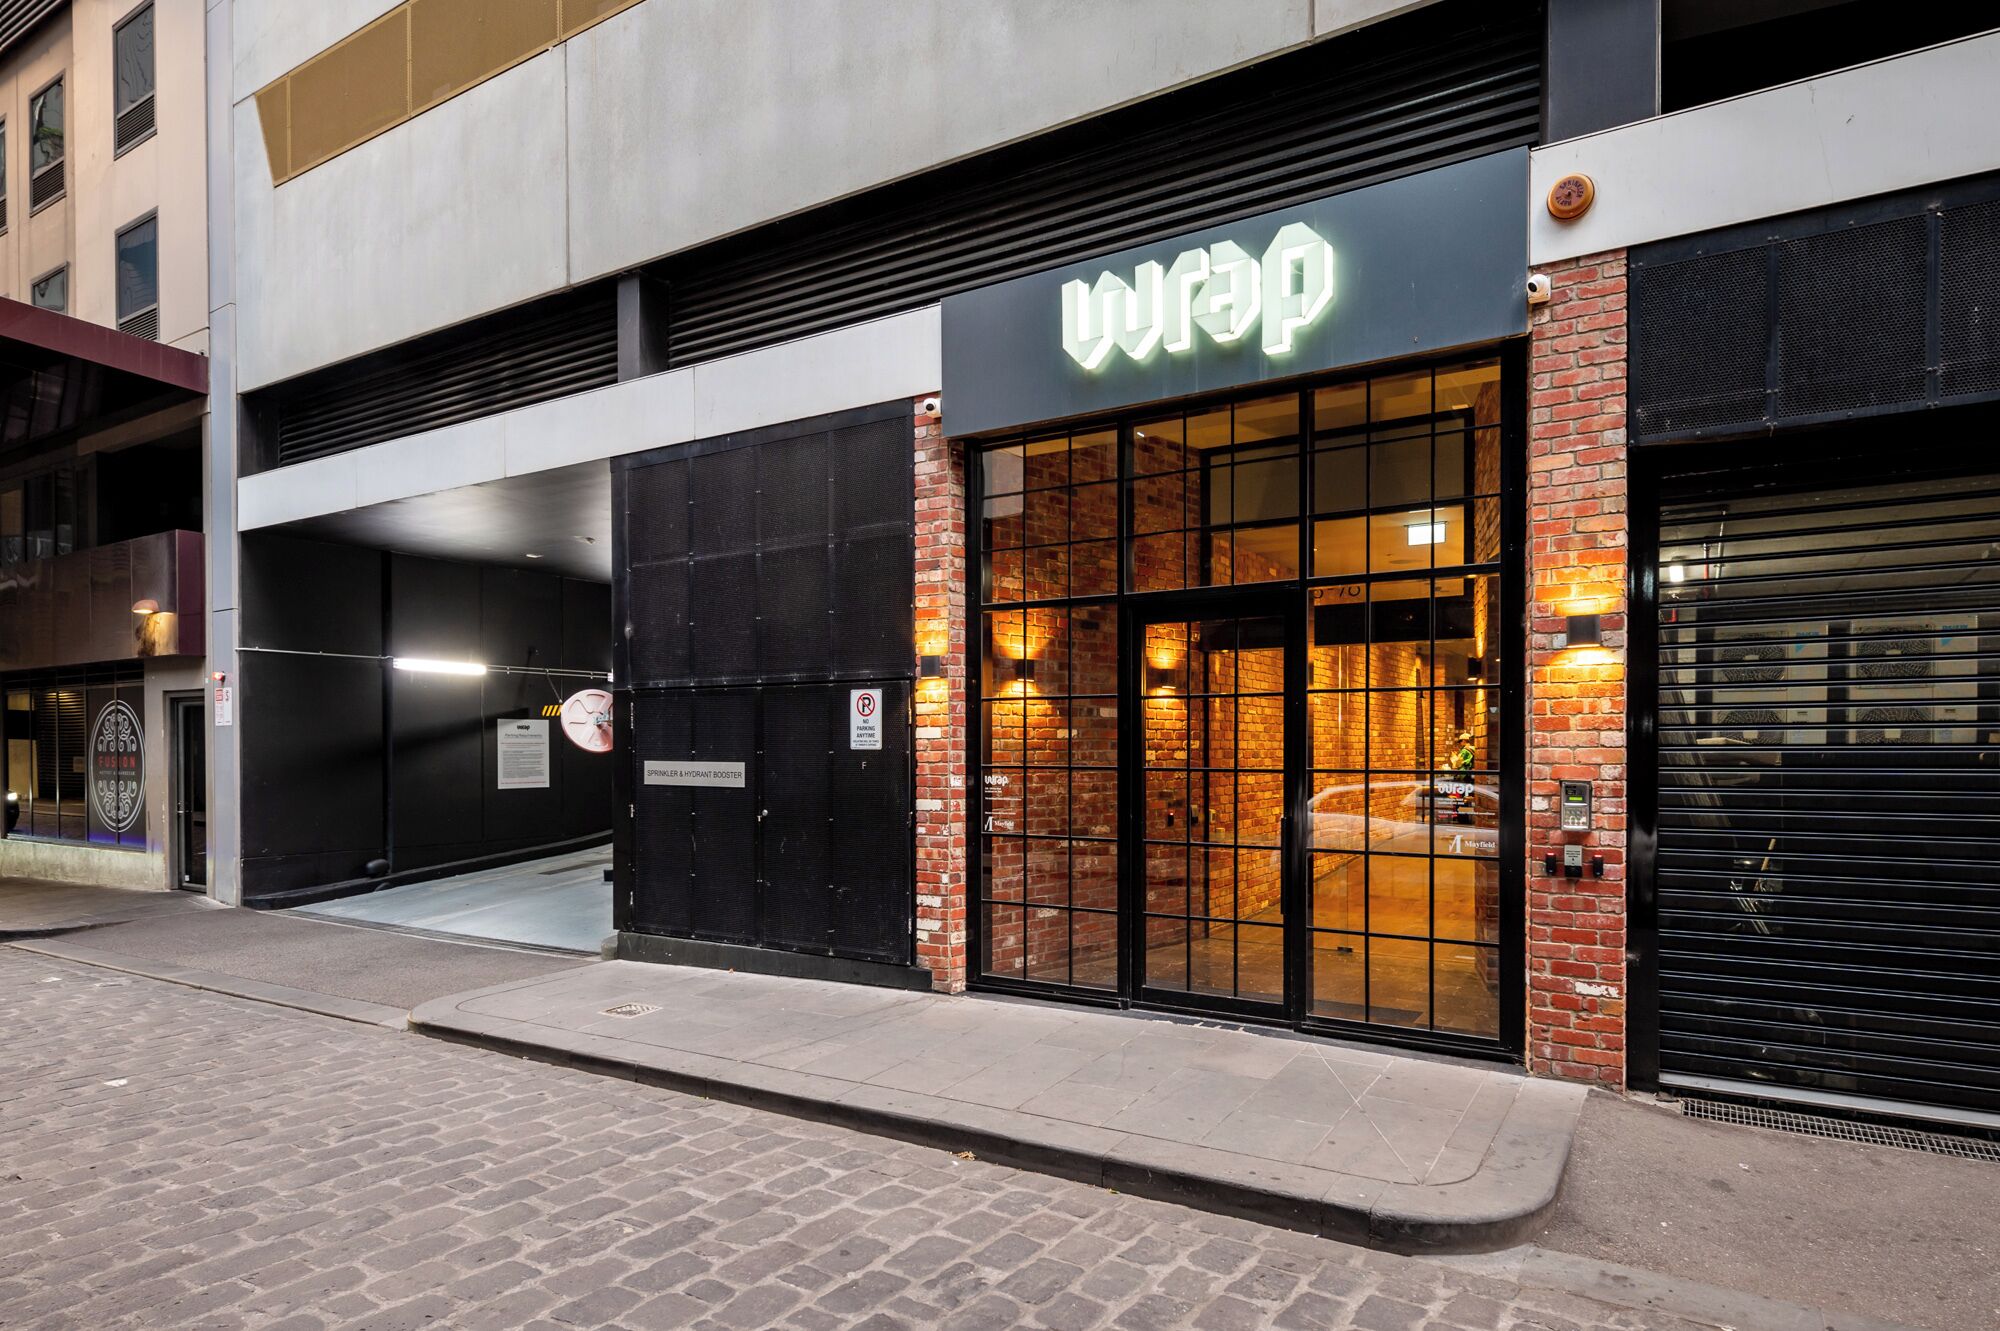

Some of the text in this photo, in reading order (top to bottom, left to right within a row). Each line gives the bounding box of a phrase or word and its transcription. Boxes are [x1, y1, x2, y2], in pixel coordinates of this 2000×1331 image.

[1061, 221, 1334, 370] wrap
[647, 769, 679, 777] SPRINKLER
[684, 770, 712, 778] HYDRANT
[713, 771, 743, 779] BOOSTER
[984, 775, 1009, 787] wrap
[1437, 782, 1474, 797] wrap
[1464, 840, 1496, 849] Mayfield
